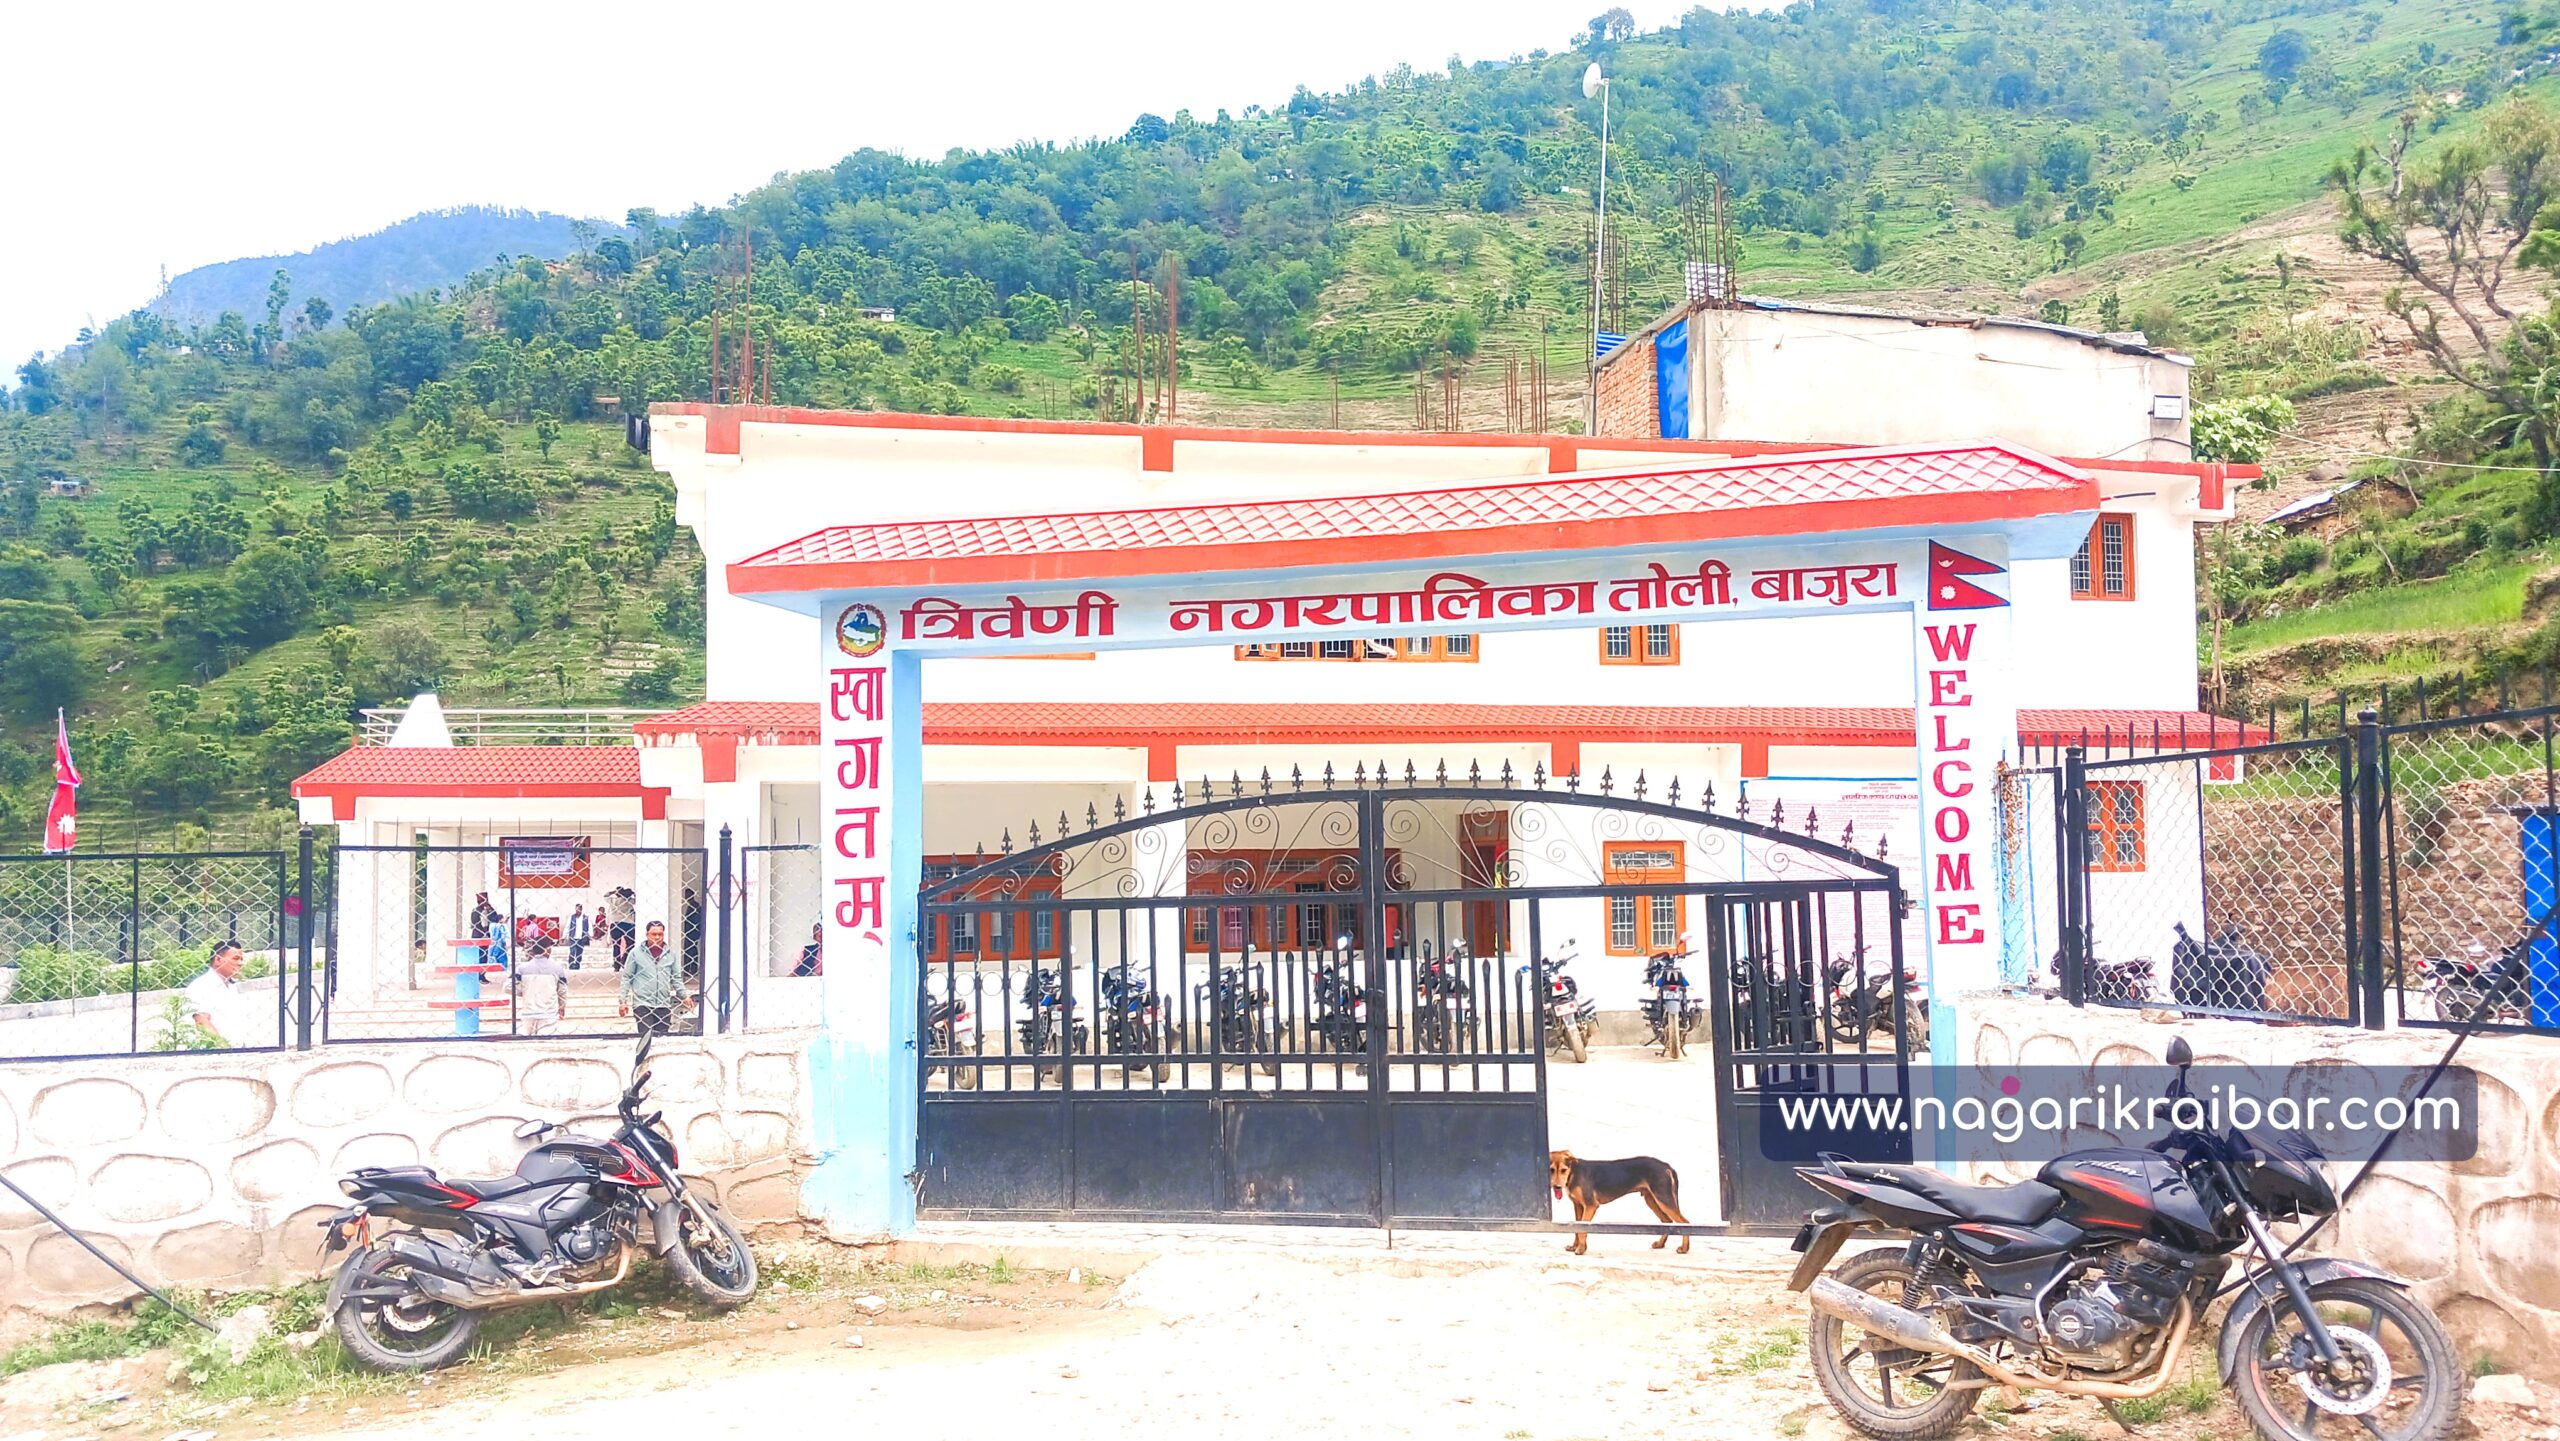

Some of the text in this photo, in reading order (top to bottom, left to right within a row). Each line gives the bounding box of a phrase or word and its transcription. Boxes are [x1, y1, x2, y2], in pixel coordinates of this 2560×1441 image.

[901, 559, 1898, 640] त्रिवेणी नगरपालिका तोली, बाजुरा
[1923, 623, 1985, 945] WELCOME
